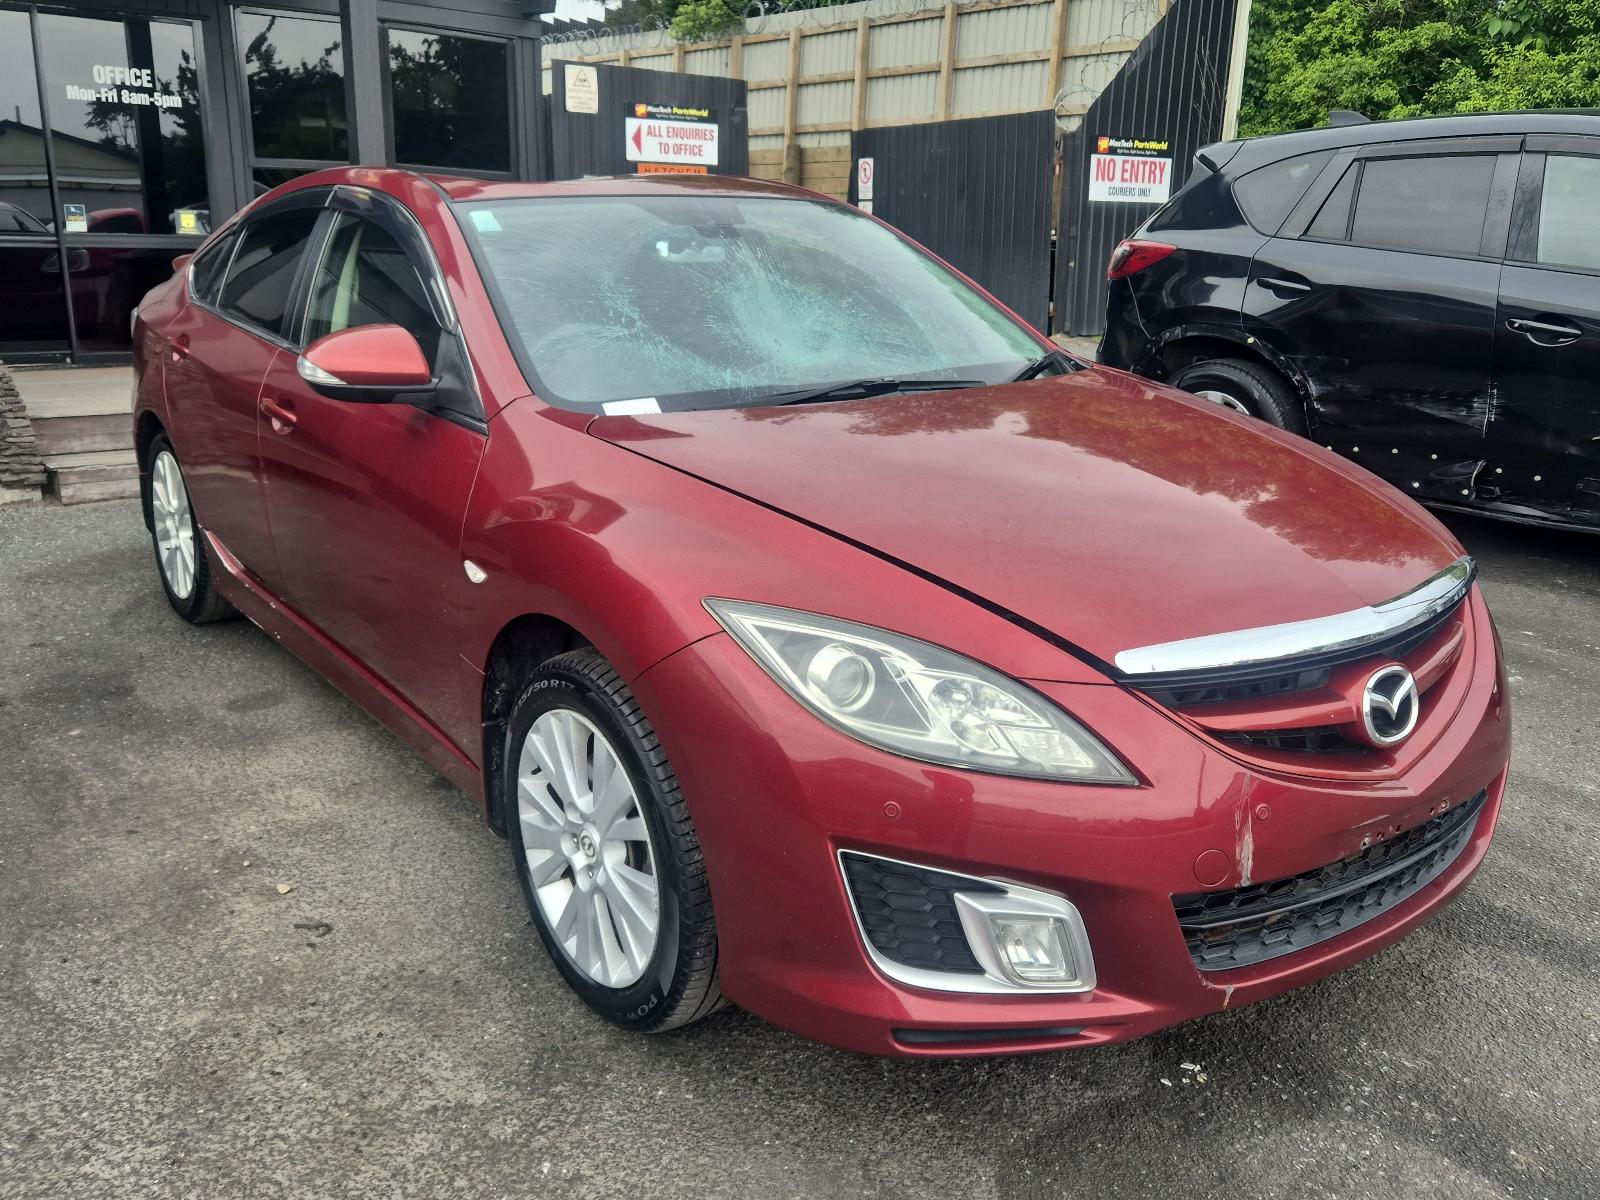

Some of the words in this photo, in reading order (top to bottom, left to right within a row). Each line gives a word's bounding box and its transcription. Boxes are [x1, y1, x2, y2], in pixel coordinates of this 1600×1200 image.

[92, 64, 153, 88] OFFICE
[65, 85, 118, 103] Mon-Fri
[121, 89, 183, 109] 8am-5pm
[646, 125, 663, 137] ALL
[666, 126, 715, 142] ENQUIRIES
[658, 142, 670, 155] TO
[672, 143, 704, 157] OFFICE
[1134, 140, 1168, 150] PartsWorld
[1095, 157, 1117, 183] NO
[1120, 159, 1167, 185] ENTRY
[1108, 186, 1136, 196] COURIERS
[1137, 187, 1152, 198] ONLY
